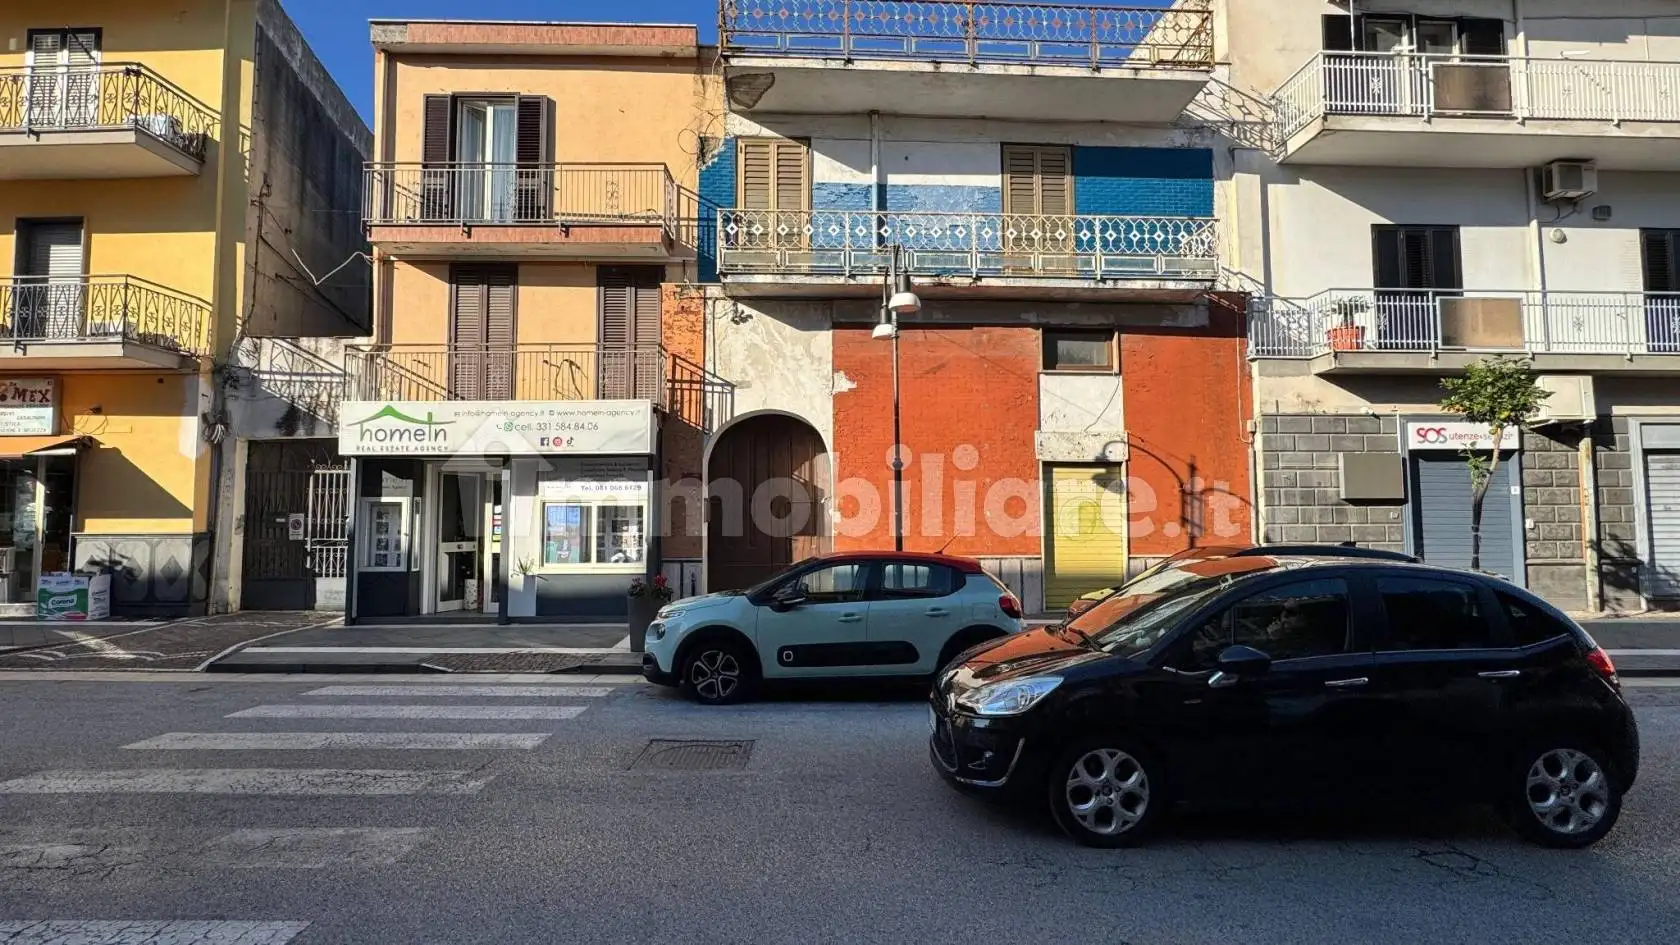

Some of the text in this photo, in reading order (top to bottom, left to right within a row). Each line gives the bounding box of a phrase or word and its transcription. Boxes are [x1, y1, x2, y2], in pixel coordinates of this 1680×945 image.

[11, 387, 51, 403] MEX
[1416, 427, 1448, 444] SOS
[355, 445, 449, 453] REAL ESTATE AGENCY
